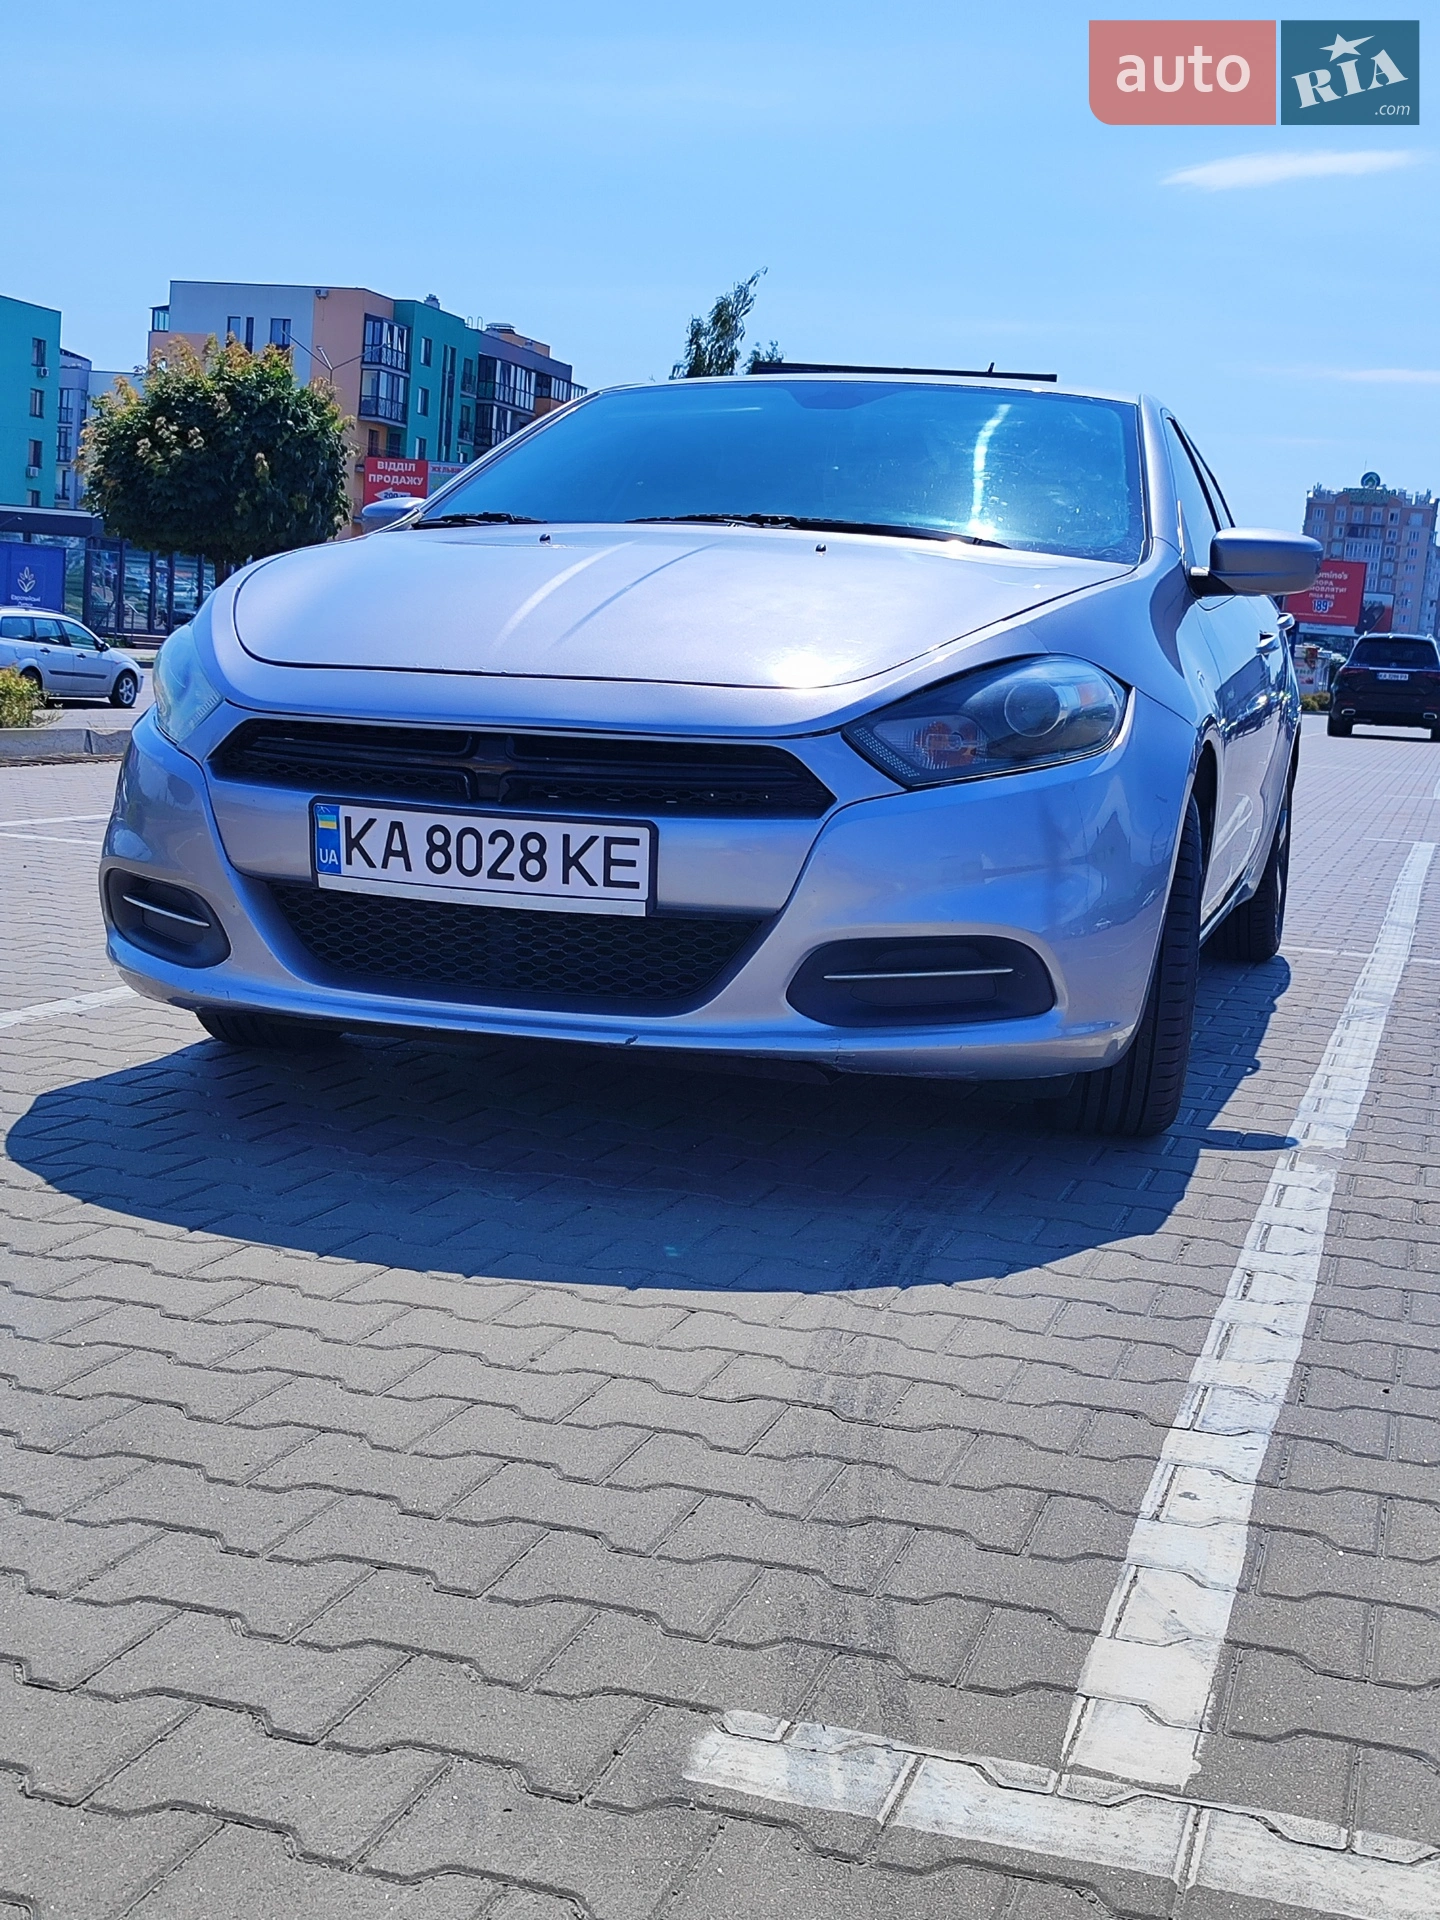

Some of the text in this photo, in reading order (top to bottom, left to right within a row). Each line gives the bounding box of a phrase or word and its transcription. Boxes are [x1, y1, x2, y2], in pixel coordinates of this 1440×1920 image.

[377, 461, 416, 472] ВІДДІЛ
[368, 474, 424, 486] ПРОДАЖУ
[1318, 571, 1349, 580] omino's
[319, 816, 640, 890] UA KA 8028 KE
